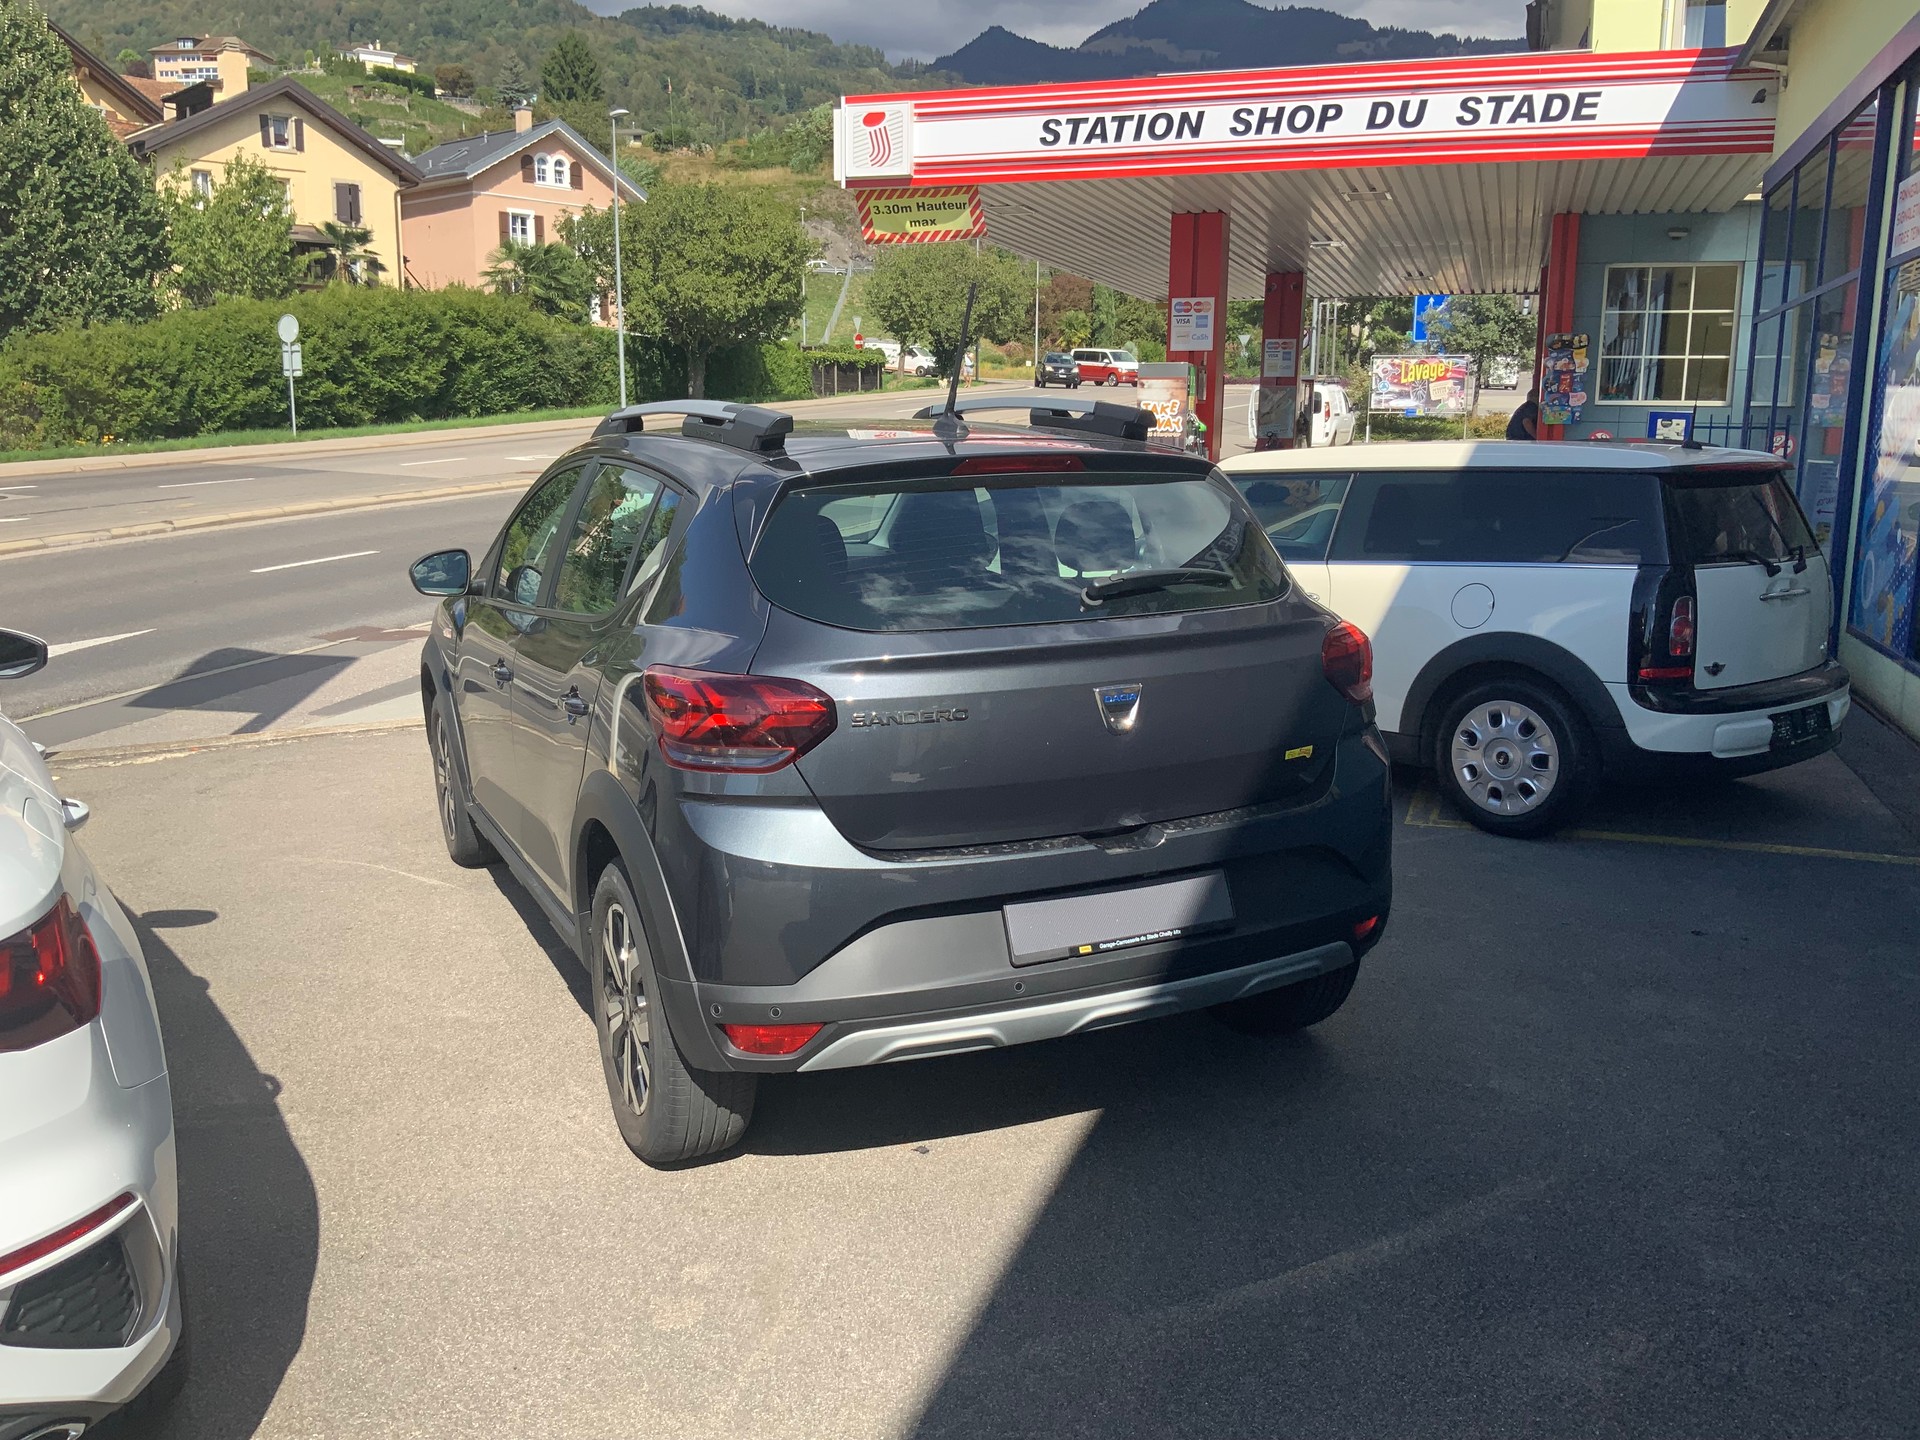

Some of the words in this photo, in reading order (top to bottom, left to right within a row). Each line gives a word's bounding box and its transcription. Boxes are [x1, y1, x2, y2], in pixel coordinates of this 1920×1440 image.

[1039, 111, 1205, 146] STATION
[1229, 103, 1344, 137] SHOP
[1366, 99, 1429, 131] DU
[1455, 91, 1604, 126] STADE
[873, 204, 912, 215] 3.30m
[916, 201, 968, 212] Hauteur
[909, 217, 937, 228] max
[1400, 360, 1446, 384] Lavage
[1142, 401, 1179, 415] TAKE
[1104, 693, 1137, 704] DACIA
[851, 708, 970, 728] SANDERO
[1147, 932, 1159, 940] Stade
